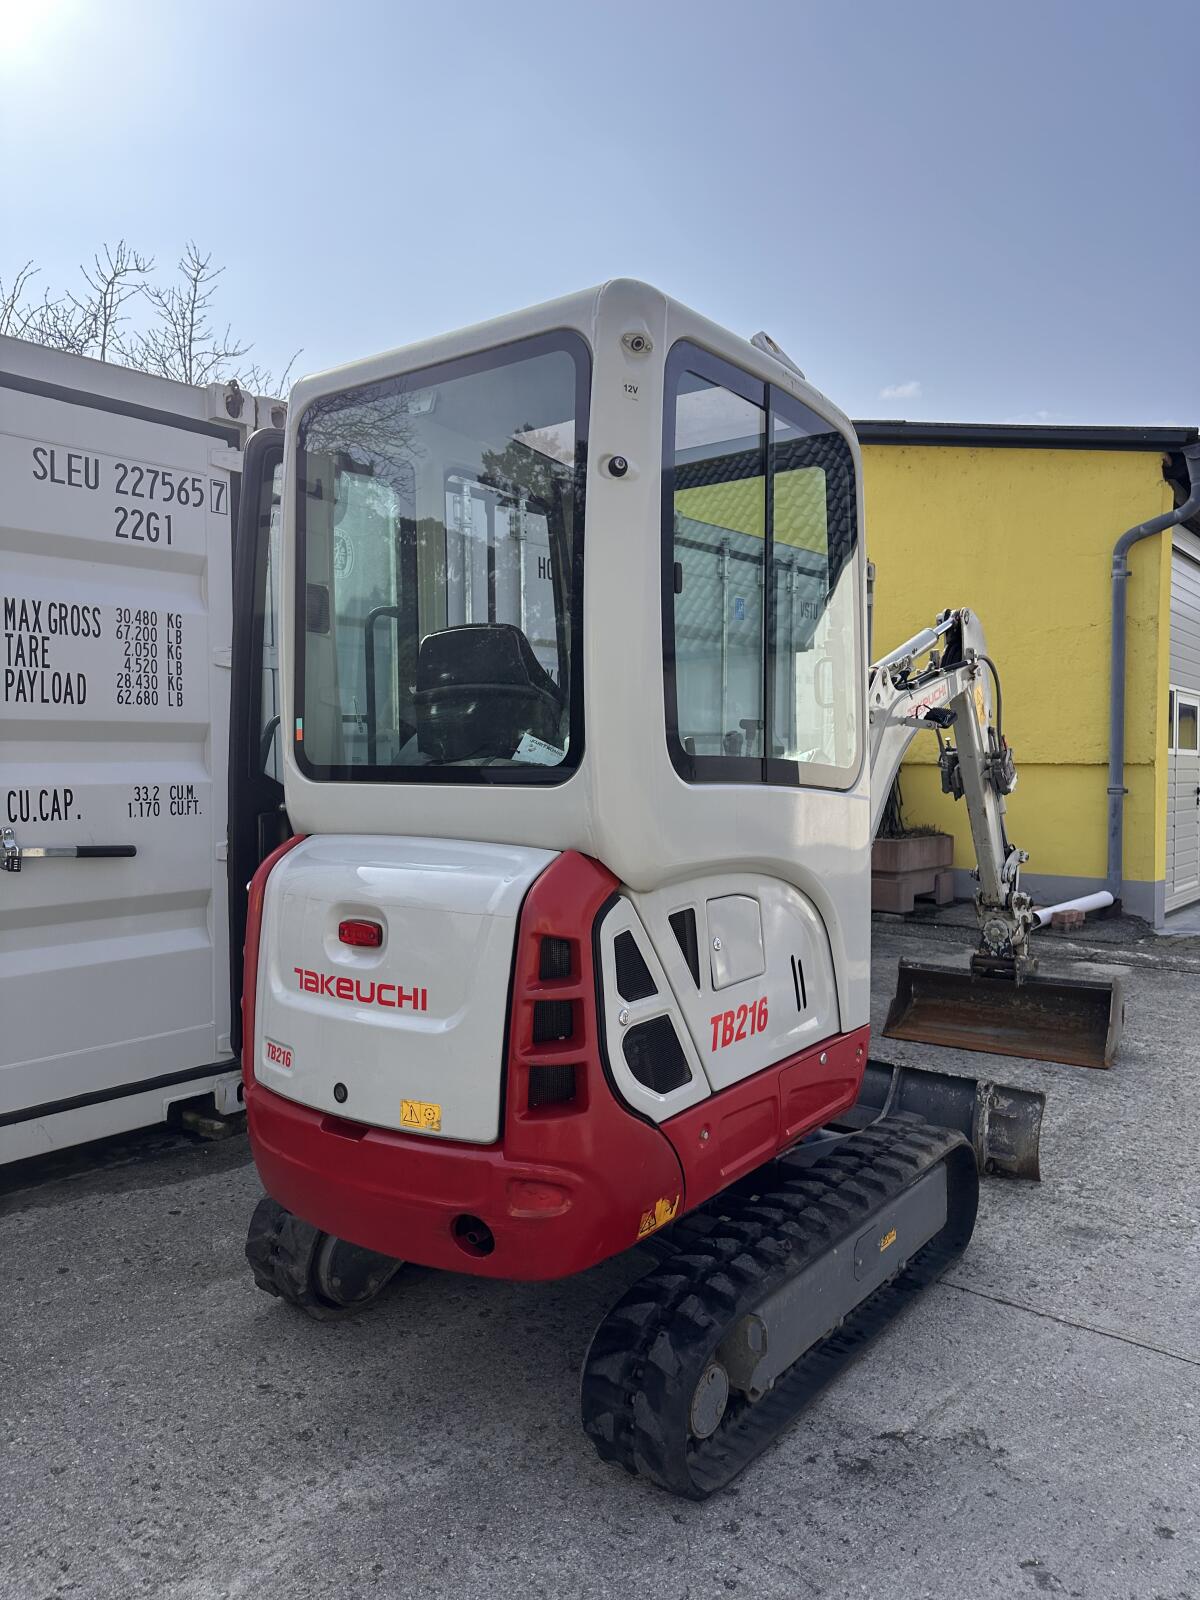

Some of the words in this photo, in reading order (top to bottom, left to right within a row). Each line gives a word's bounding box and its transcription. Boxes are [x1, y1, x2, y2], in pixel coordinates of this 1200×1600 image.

[624, 384, 639, 394] 12V
[32, 447, 99, 490] SLEU
[114, 463, 204, 507] 227565
[211, 480, 226, 513] 7
[114, 507, 172, 544] 22G1
[4, 597, 43, 633] MAX
[49, 603, 101, 638] GROSS
[116, 608, 157, 626] 30.480
[167, 615, 182, 629] KG
[116, 626, 157, 642] 67.200
[167, 630, 182, 644] LB
[5, 633, 50, 668] TARE
[124, 641, 157, 658] 2.050
[167, 645, 182, 660] KG
[124, 657, 157, 674] 4.520
[167, 661, 182, 675] LB
[5, 669, 86, 704] PAYLOAD
[116, 674, 158, 690] 28.430
[167, 676, 183, 691] KG
[116, 690, 158, 705] 62.680
[168, 692, 183, 706] LB
[134, 786, 159, 801] 33.2
[127, 801, 160, 818] 1.170
[710, 996, 768, 1053] TB216
[267, 1042, 292, 1067] TB216
